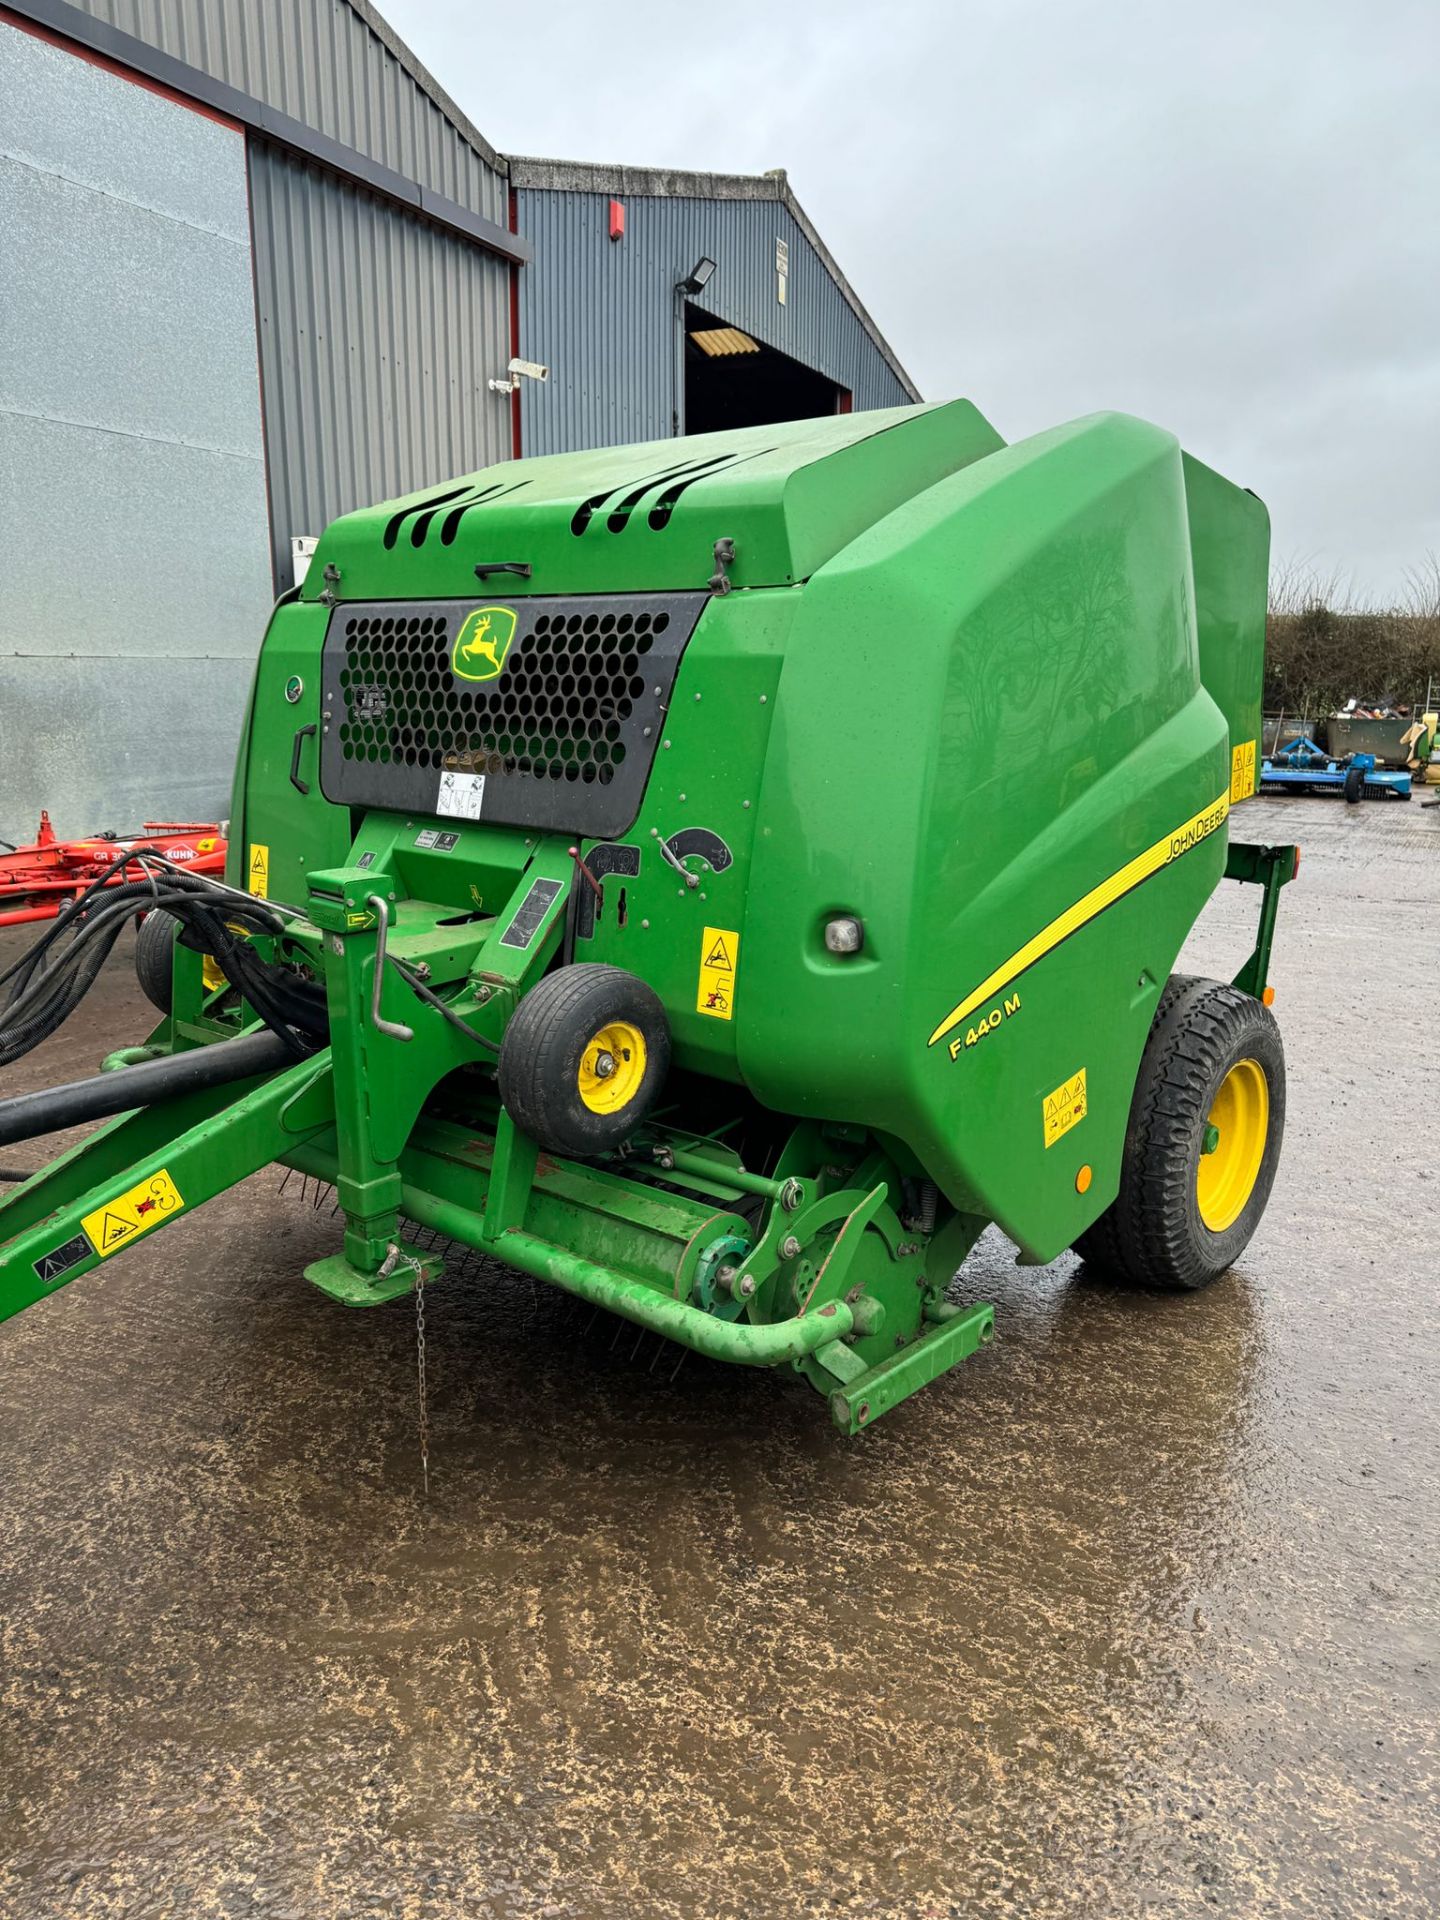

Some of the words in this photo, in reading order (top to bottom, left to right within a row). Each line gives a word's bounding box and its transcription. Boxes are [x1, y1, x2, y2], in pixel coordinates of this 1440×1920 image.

[166, 849, 193, 860] KUHN
[1166, 827, 1196, 861] JOHN
[1196, 805, 1224, 840] DEERE
[948, 1037, 962, 1062] F
[964, 1008, 1003, 1048] 440
[1003, 992, 1021, 1017] M
